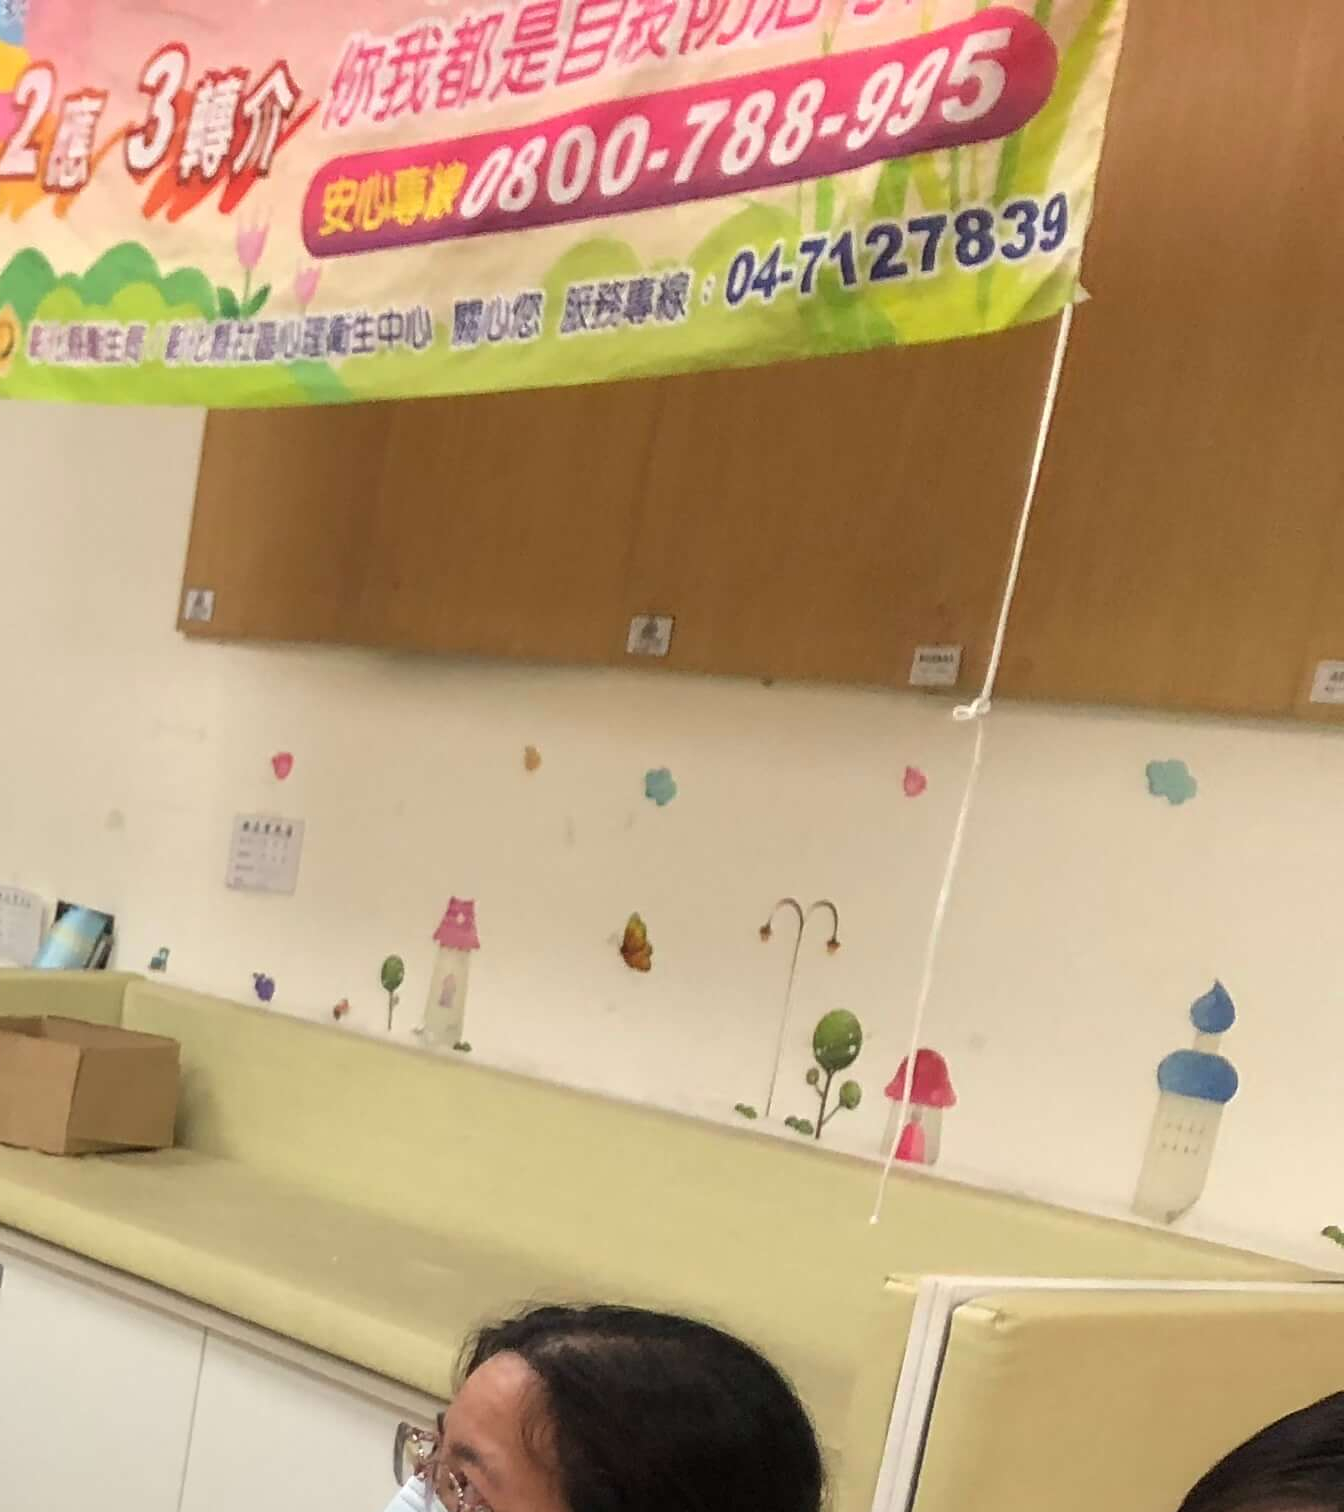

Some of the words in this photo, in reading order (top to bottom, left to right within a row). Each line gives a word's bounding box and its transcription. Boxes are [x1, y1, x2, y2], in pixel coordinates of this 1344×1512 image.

[460, 24, 1014, 220] 0800-788-995
[319, 162, 467, 236] 安心專線
[724, 192, 1070, 305] 04-7127839
